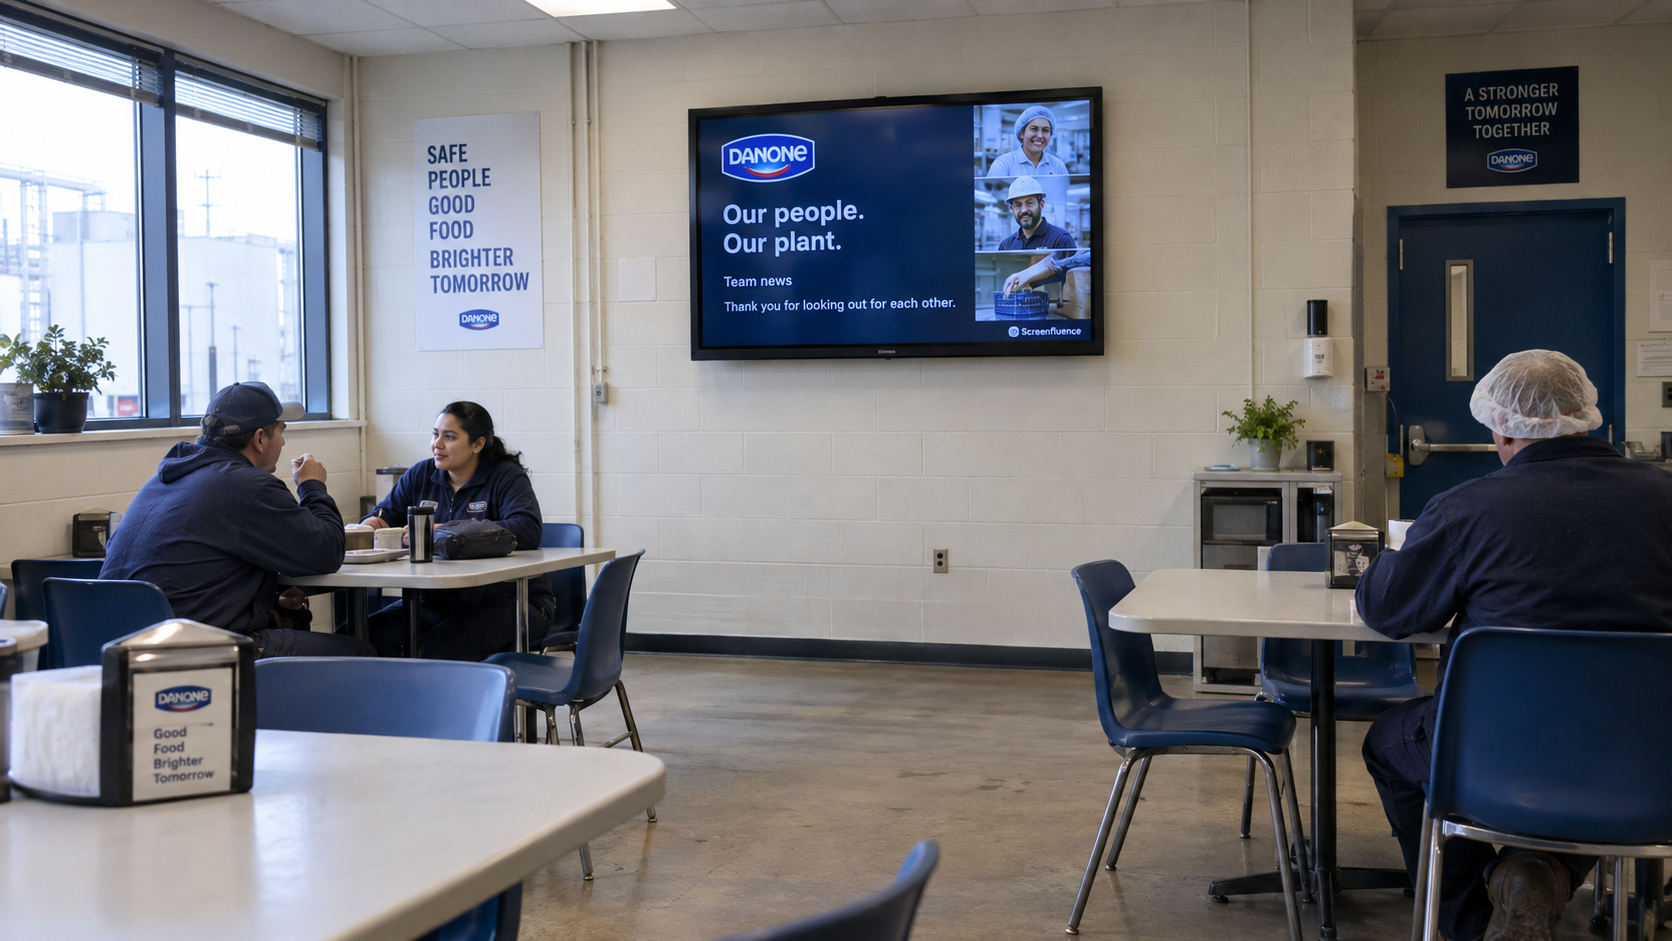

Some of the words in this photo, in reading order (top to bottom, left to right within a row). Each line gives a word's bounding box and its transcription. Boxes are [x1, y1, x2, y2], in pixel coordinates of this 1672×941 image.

[1464, 88, 1474, 102] A
[1479, 83, 1559, 101] STRONGER
[1466, 102, 1558, 120] TOMORROW
[1473, 122, 1550, 139] TOGETHER
[427, 143, 468, 164] SAFE
[428, 167, 491, 190] PEOPLE
[429, 194, 475, 215] GOOD
[723, 203, 767, 225] Our
[774, 200, 865, 227] people.
[429, 220, 474, 240] FOOD
[723, 232, 767, 254] Our
[774, 230, 842, 257] plant.
[430, 247, 514, 269] BRIGHTER
[430, 272, 530, 294] TOMORROW
[724, 276, 757, 288] Team
[760, 276, 792, 287] news
[724, 300, 759, 313] Thank
[761, 302, 781, 313] you
[783, 300, 800, 311] for
[803, 299, 844, 313] looking
[847, 299, 867, 311] out
[870, 298, 887, 310] for
[890, 298, 919, 310] each
[921, 297, 956, 309] other.
[1021, 326, 1082, 337] Screenfluence
[154, 726, 187, 739] Good
[154, 741, 185, 754] Food
[153, 755, 204, 770] Brighter
[153, 770, 215, 784] Tomorrow
